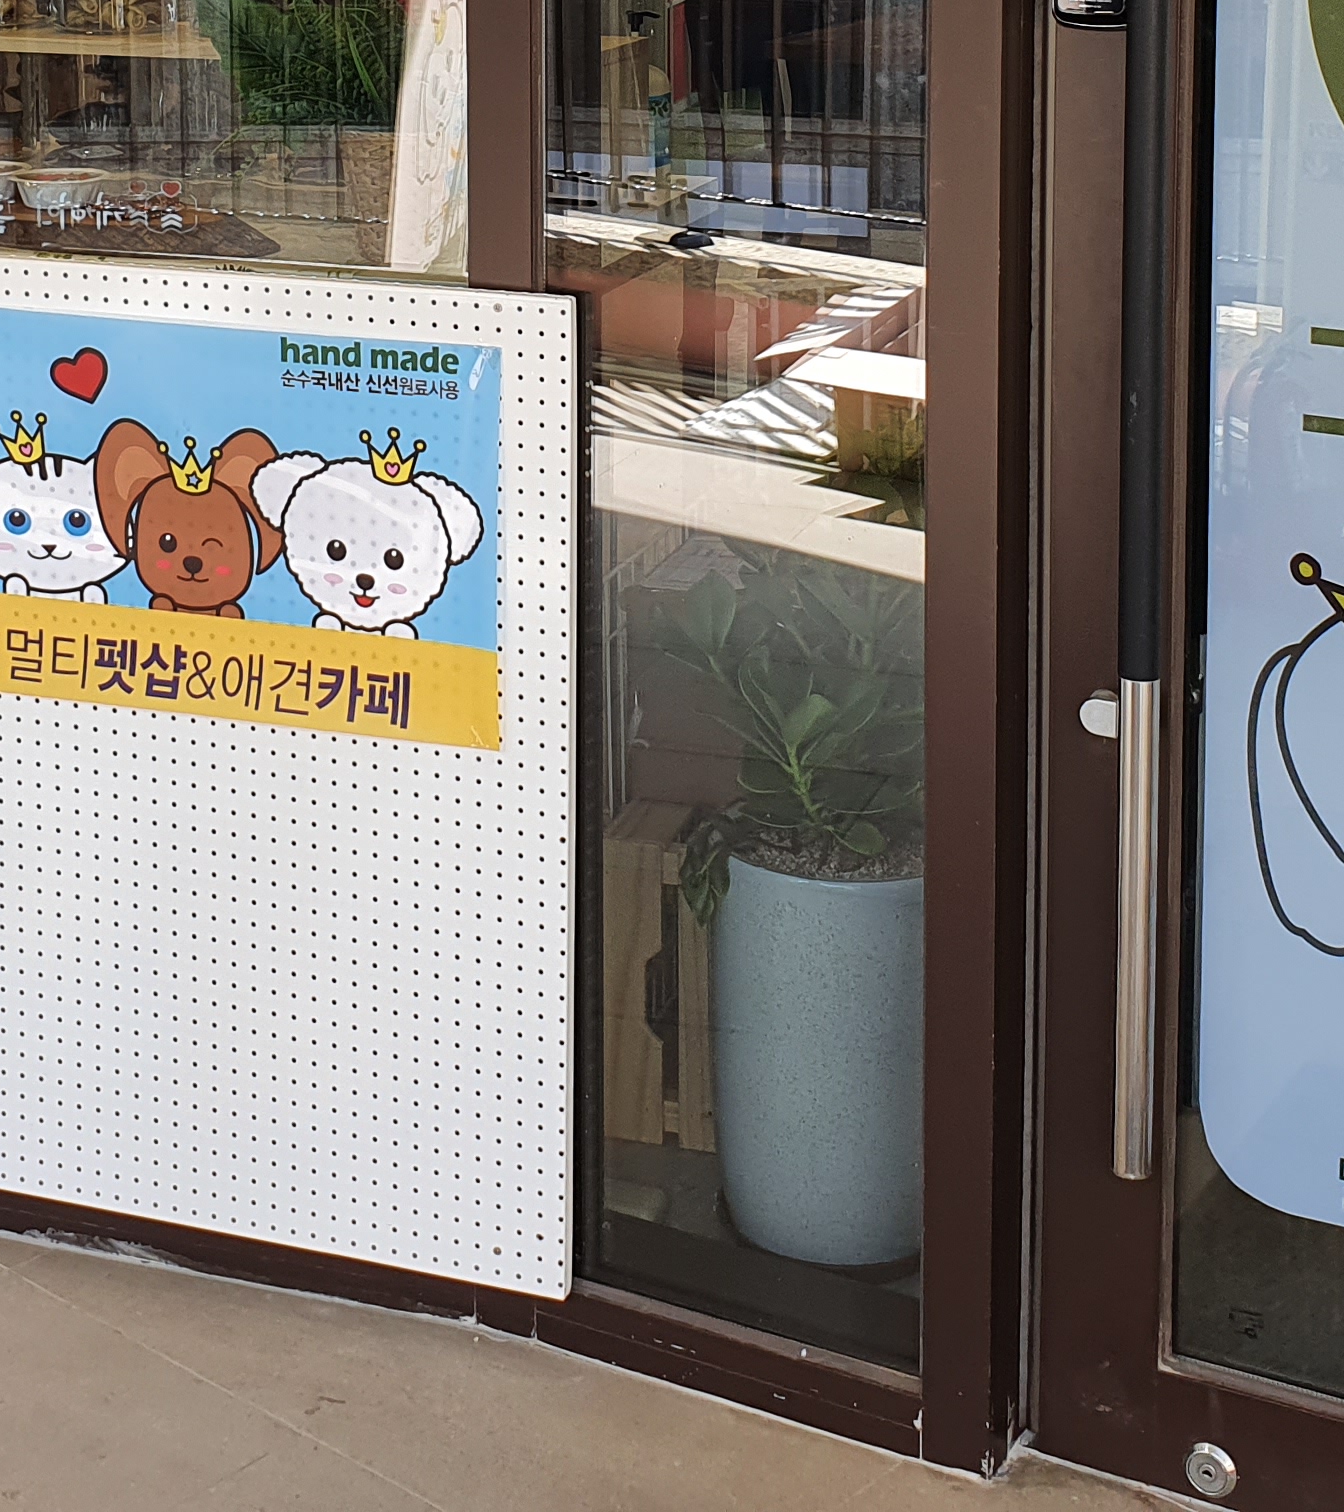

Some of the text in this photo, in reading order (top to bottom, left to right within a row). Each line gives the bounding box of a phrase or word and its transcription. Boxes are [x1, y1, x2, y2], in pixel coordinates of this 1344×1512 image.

[280, 336, 460, 376] hand made
[280, 368, 460, 401] 순수국내산 신선원료사용
[4, 626, 413, 729] 멀티펫샵&애견카페
